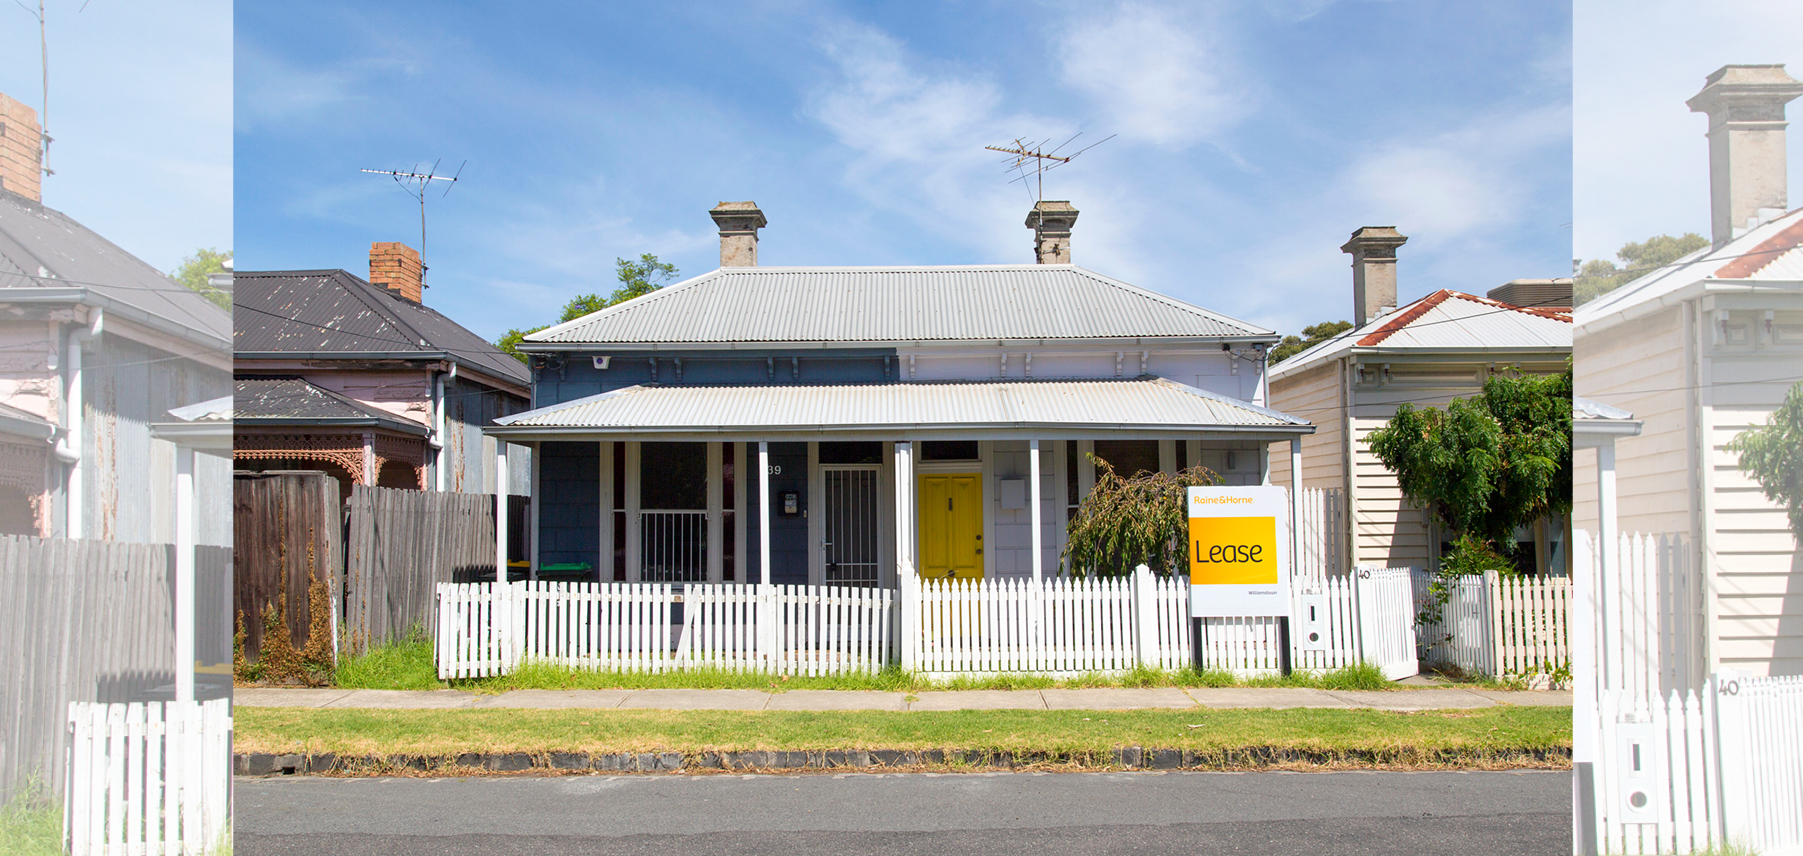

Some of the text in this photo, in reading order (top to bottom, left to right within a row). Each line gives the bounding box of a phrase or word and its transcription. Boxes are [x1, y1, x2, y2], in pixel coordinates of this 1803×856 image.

[1196, 540, 1263, 563] Lease
[1358, 569, 1370, 579] 40
[1719, 679, 1739, 695] 40
